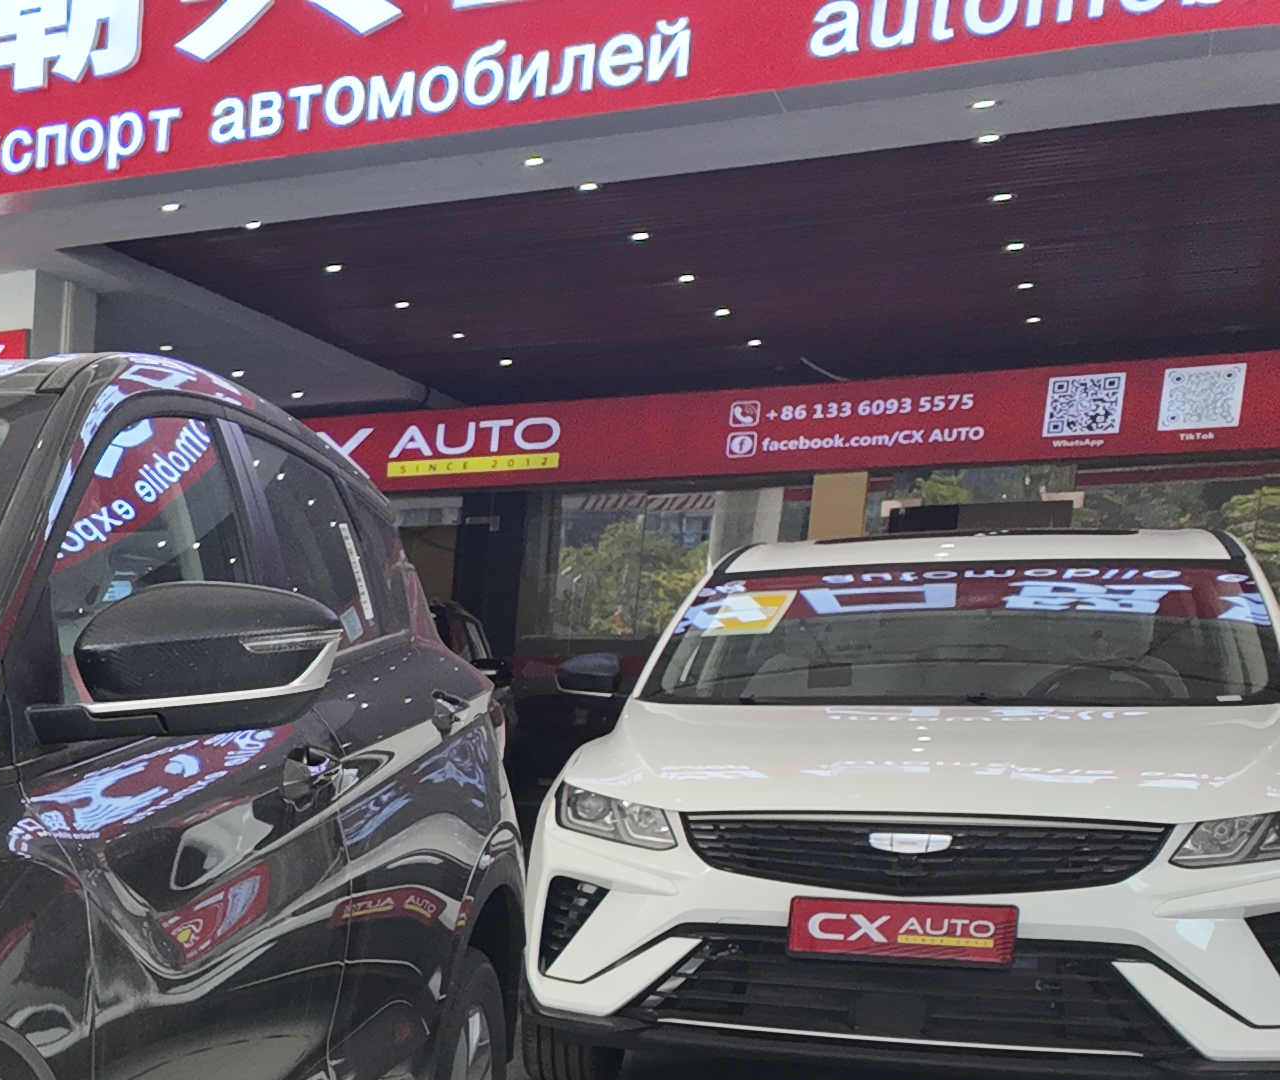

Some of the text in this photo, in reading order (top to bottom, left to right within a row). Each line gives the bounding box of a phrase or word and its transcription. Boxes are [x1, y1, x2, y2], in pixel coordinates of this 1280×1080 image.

[208, 16, 693, 145] автомобилей
[765, 393, 974, 421] +86 133 6093 5575
[316, 416, 561, 479] X AUTO
[761, 426, 985, 453] facebook.com/CX AUTO
[1052, 438, 1105, 449] WhatsApp
[400, 456, 549, 474] SINCE 2012
[807, 912, 995, 943] CX AUTO
